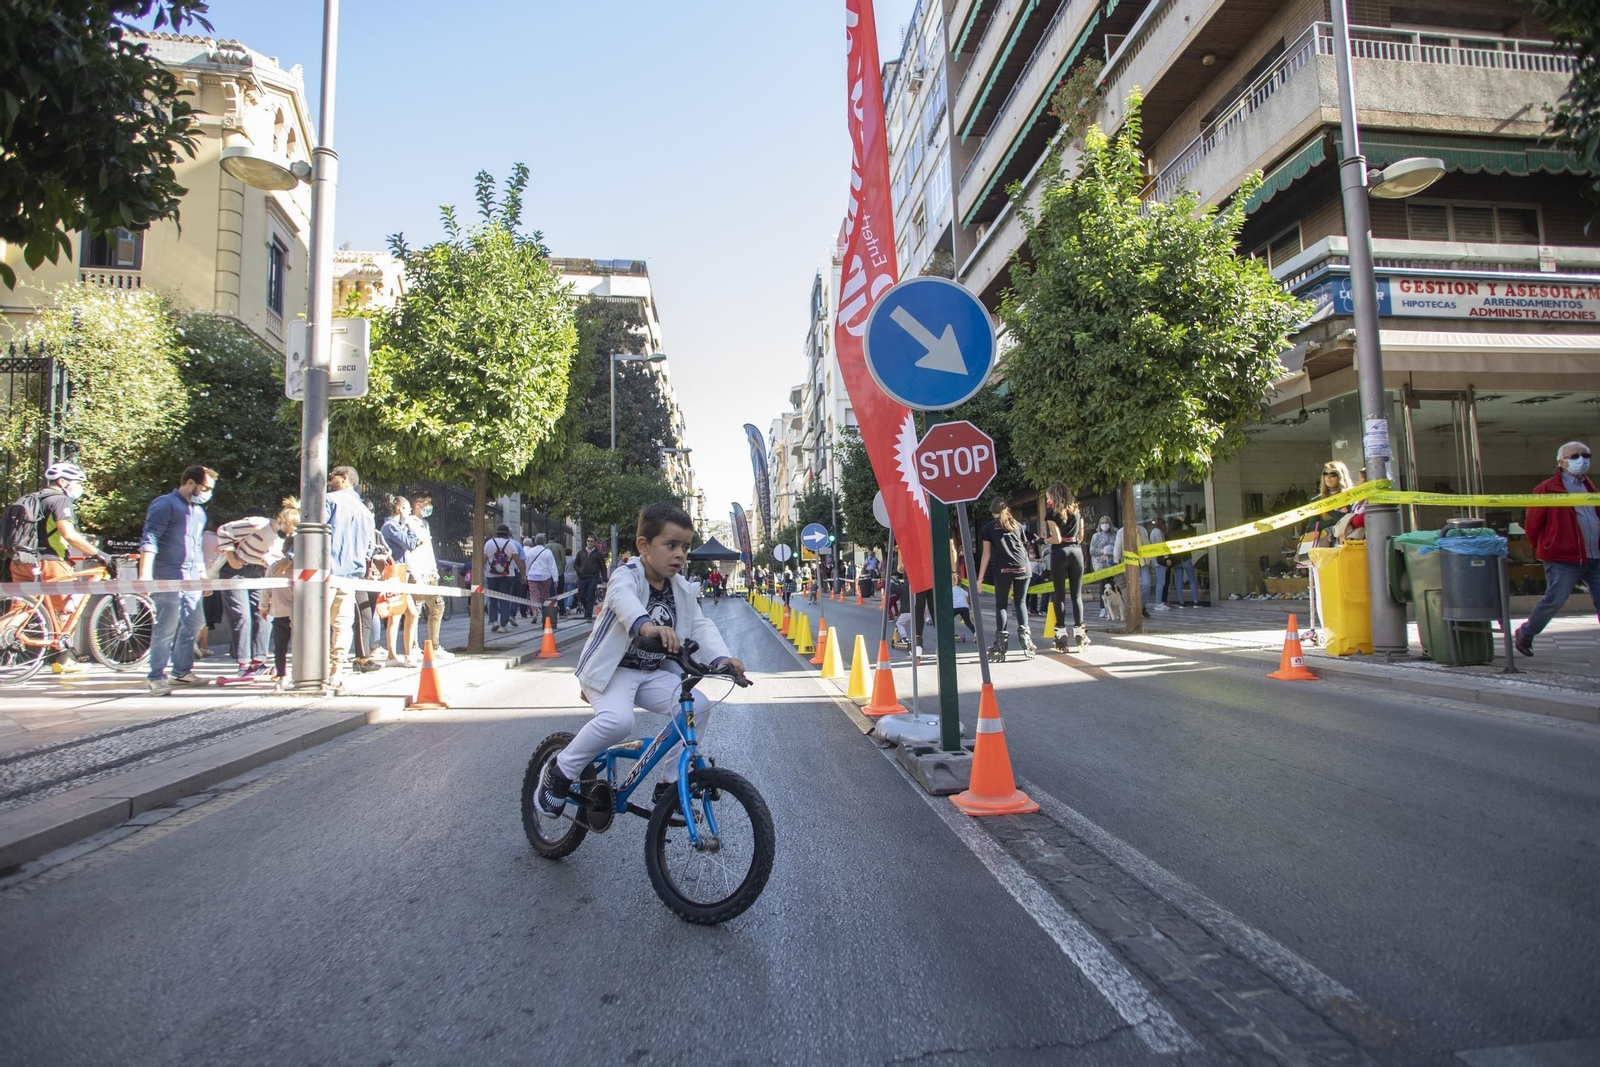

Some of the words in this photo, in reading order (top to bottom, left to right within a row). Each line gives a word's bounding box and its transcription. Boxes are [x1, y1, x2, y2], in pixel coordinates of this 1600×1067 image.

[1399, 279, 1479, 296] GESTION
[1487, 283, 1498, 296] Y
[1504, 283, 1600, 300] ASESORAM
[1402, 300, 1457, 309] HIPOTECAS
[1483, 298, 1583, 309] ARRENDAMIENTOS
[1469, 307, 1597, 320] ADMINISTRACIONES
[920, 444, 990, 480] STOP
